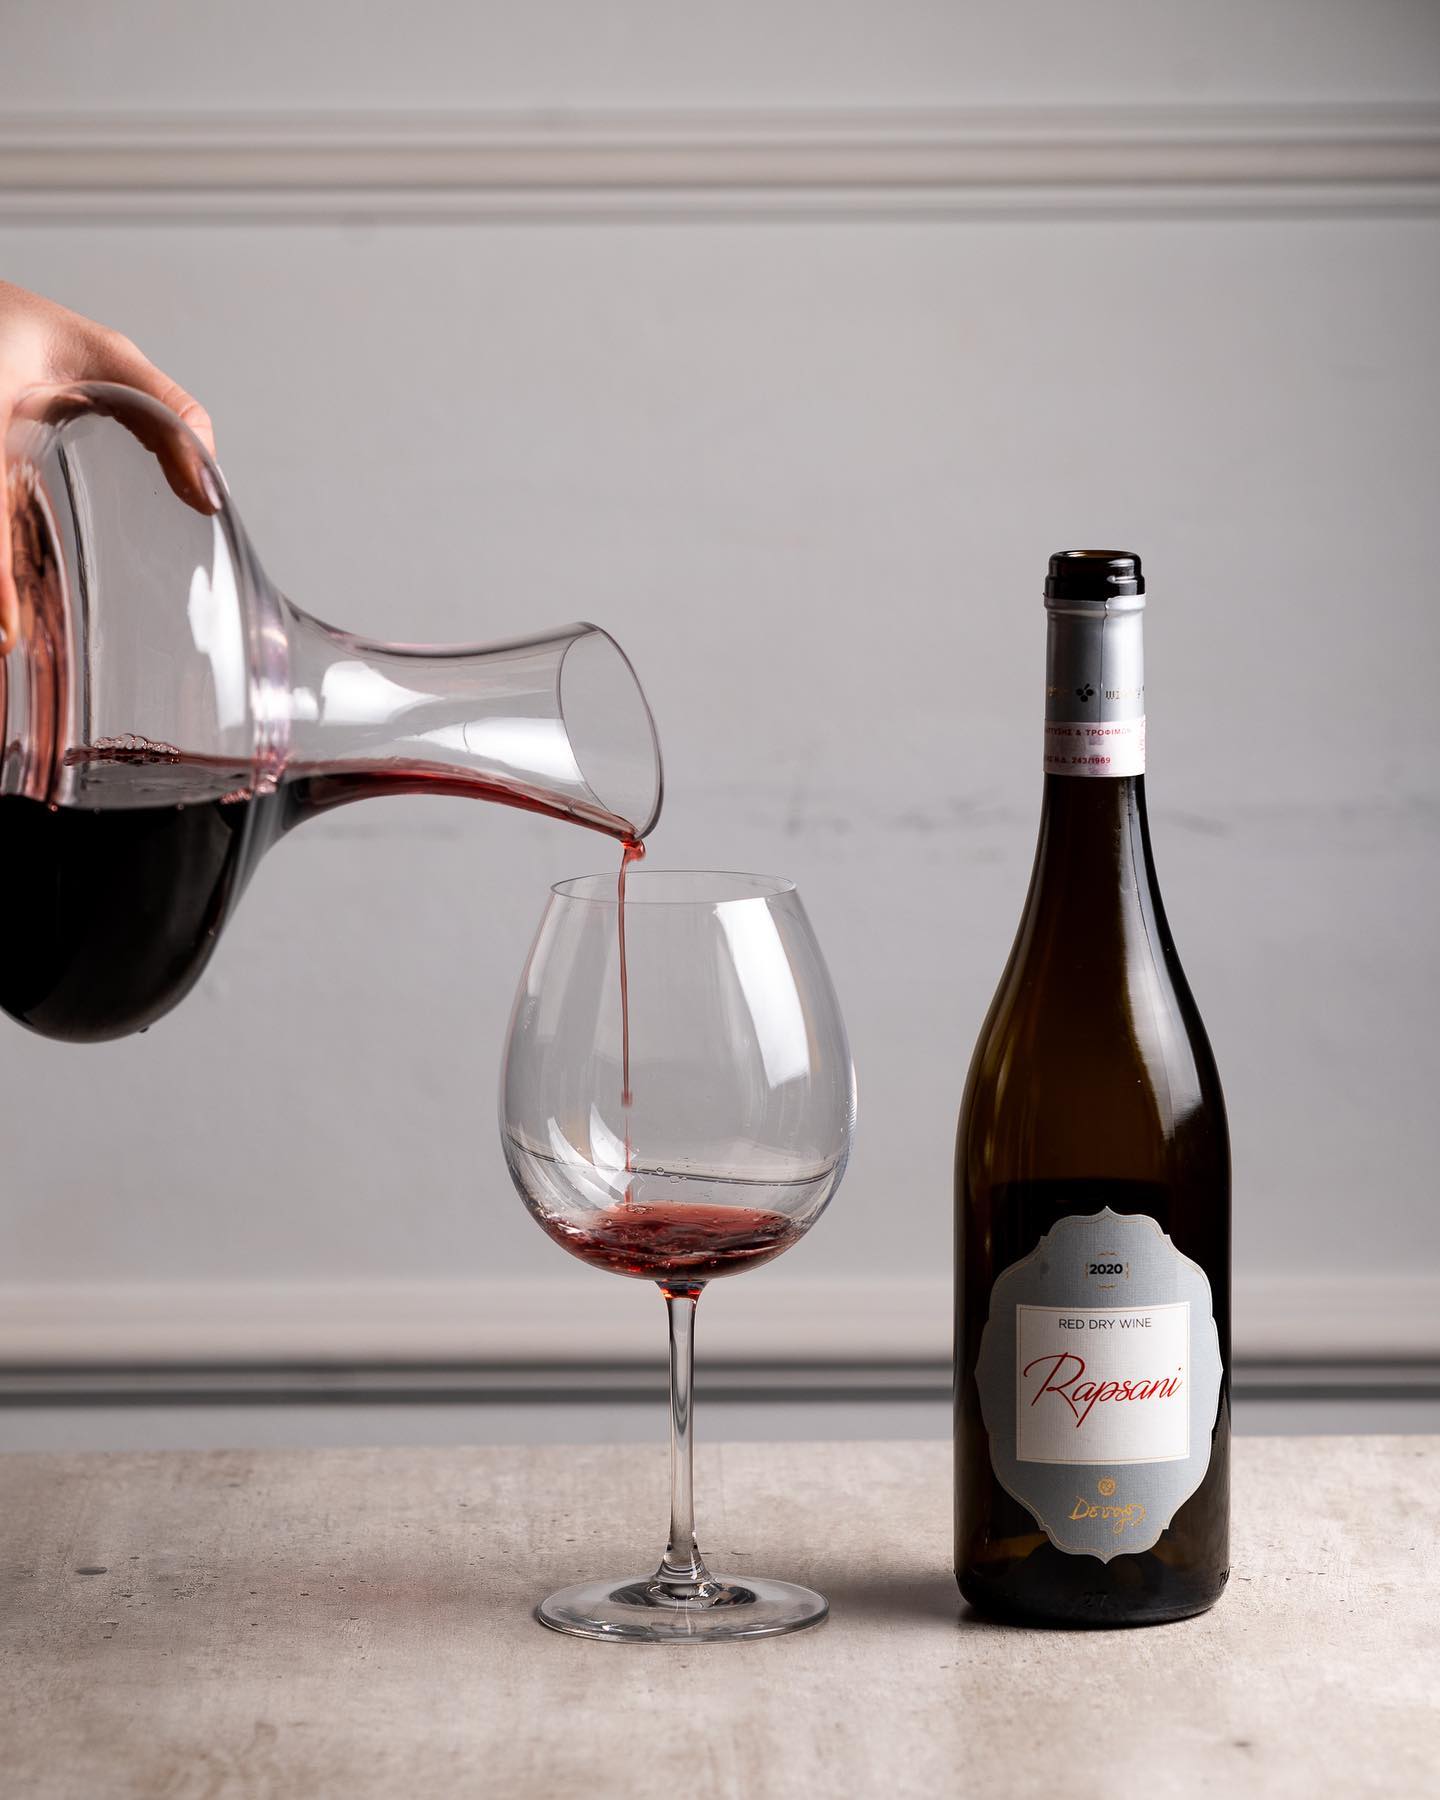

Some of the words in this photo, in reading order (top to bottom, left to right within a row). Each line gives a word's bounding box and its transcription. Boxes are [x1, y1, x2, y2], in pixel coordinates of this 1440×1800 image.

[1072, 756, 1111, 765] 243/1969
[1089, 1263, 1123, 1275] 2020
[1058, 1318, 1085, 1330] RED
[1089, 1319, 1116, 1330] DRY
[1119, 1317, 1152, 1329] WINE
[1023, 1352, 1183, 1428] Rapsani
